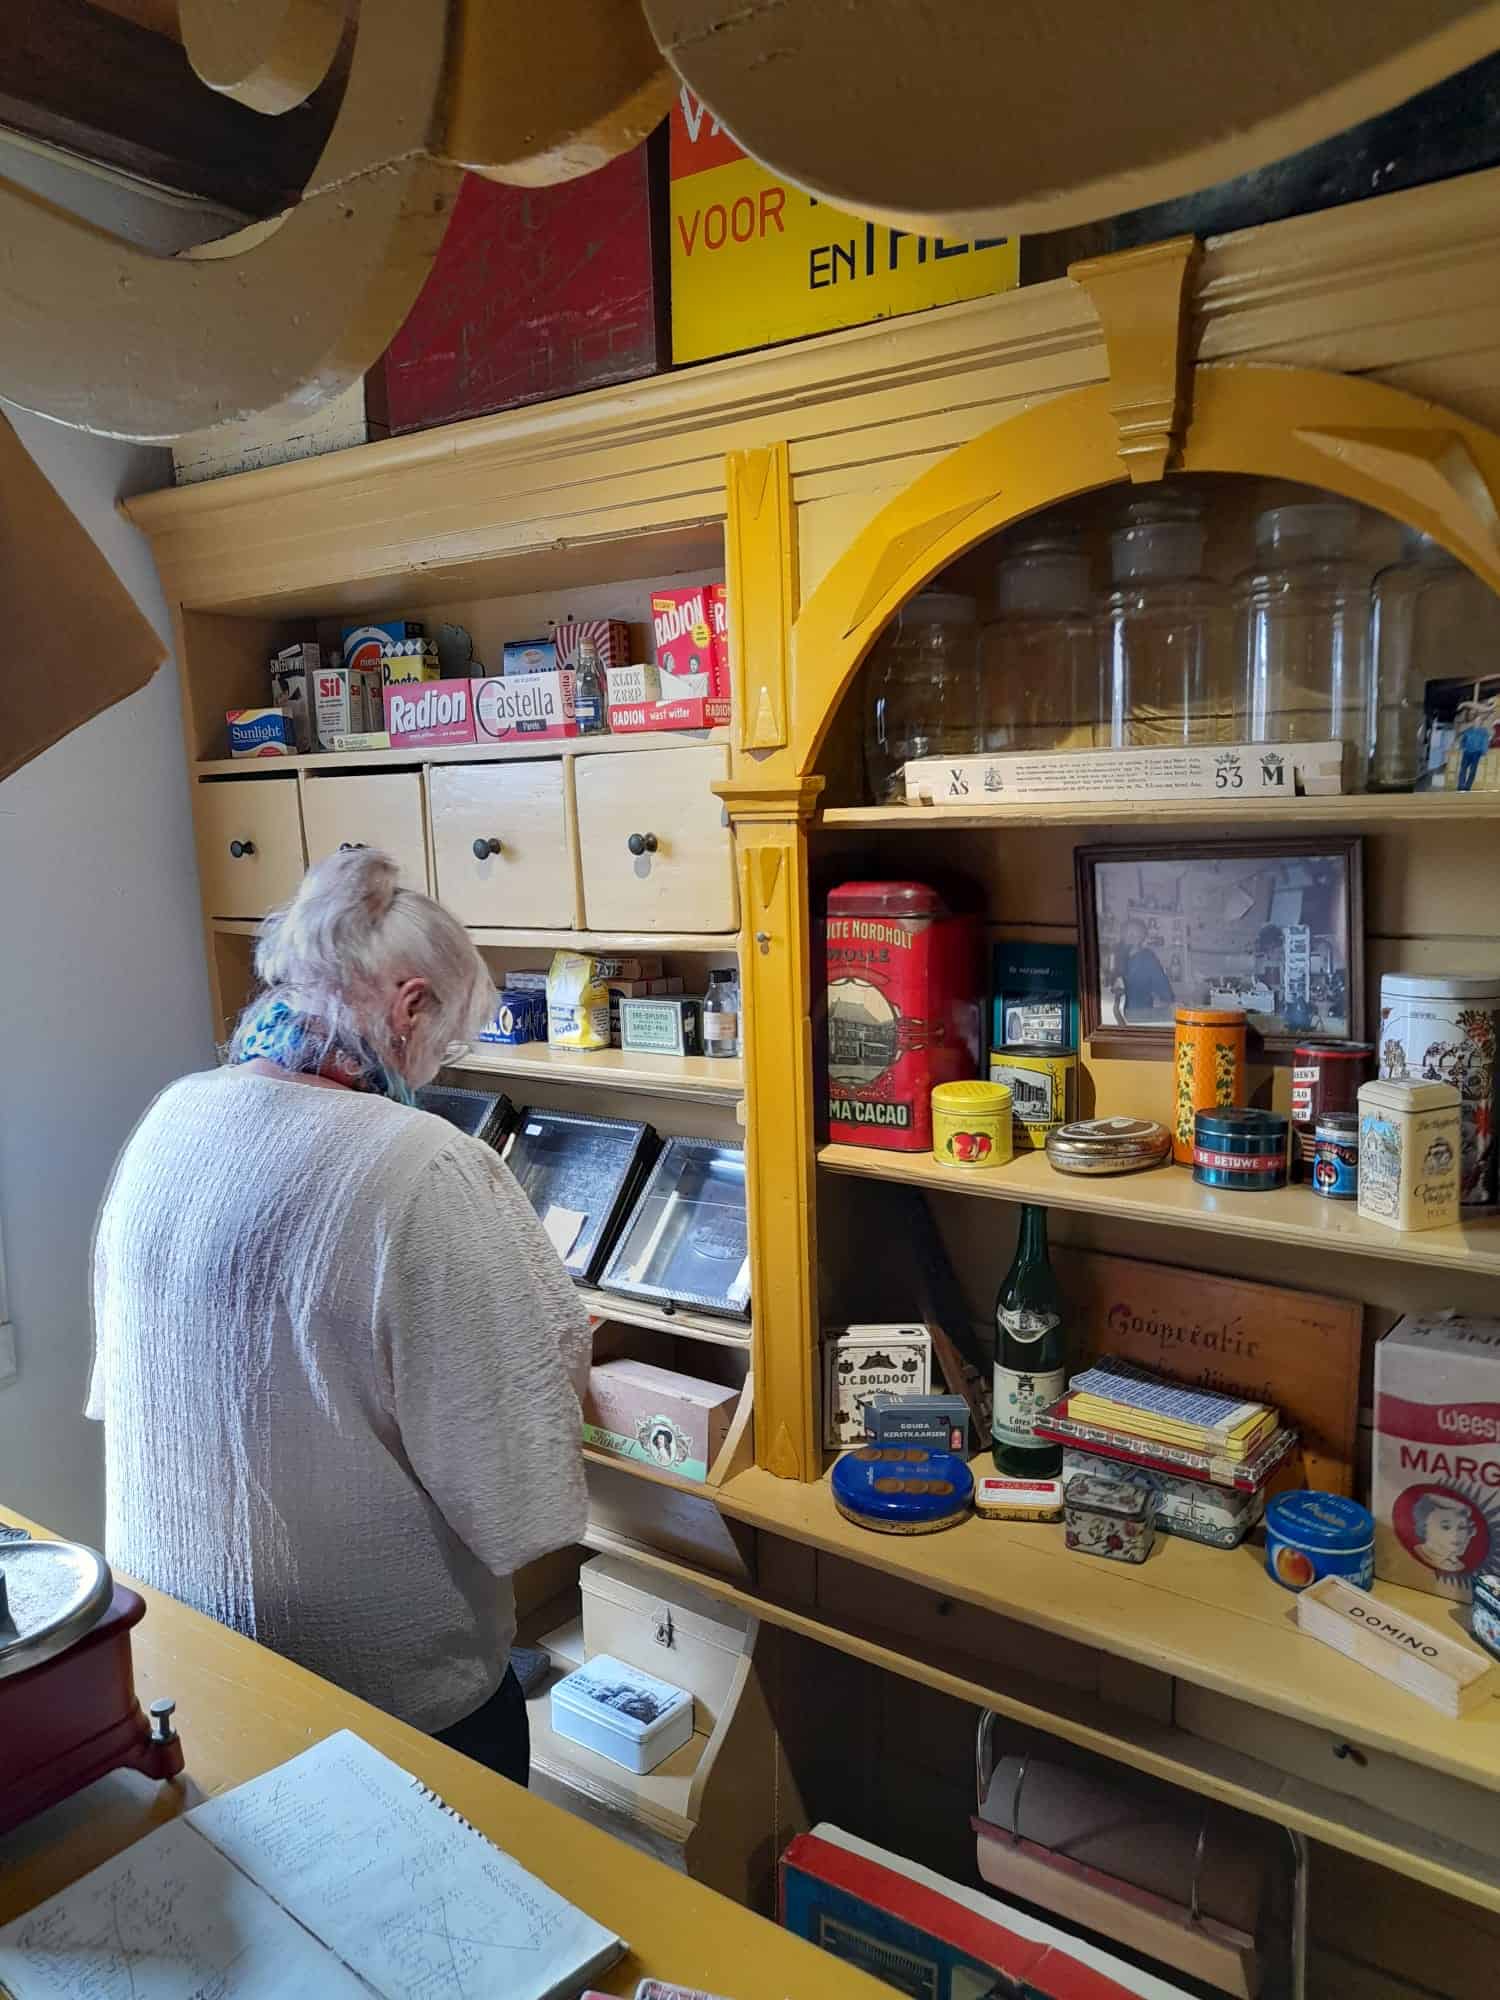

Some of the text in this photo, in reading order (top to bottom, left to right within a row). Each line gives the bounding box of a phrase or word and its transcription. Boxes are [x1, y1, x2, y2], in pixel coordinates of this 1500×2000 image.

[678, 187, 785, 257] VOOR
[810, 239, 856, 289] EN
[654, 595, 704, 648] RADION
[320, 678, 341, 698] Sil
[390, 688, 467, 735] Radion
[476, 680, 554, 738] Castella
[612, 708, 645, 727] RADION
[232, 724, 282, 741] Sunlight
[950, 769, 962, 782] V
[1215, 766, 1244, 789] 53
[1260, 766, 1285, 786] M
[852, 919, 914, 950] NORDHOLT
[554, 1022, 580, 1036] soda
[855, 1102, 908, 1127] CACAO
[1348, 1605, 1440, 1659] DOMINO
